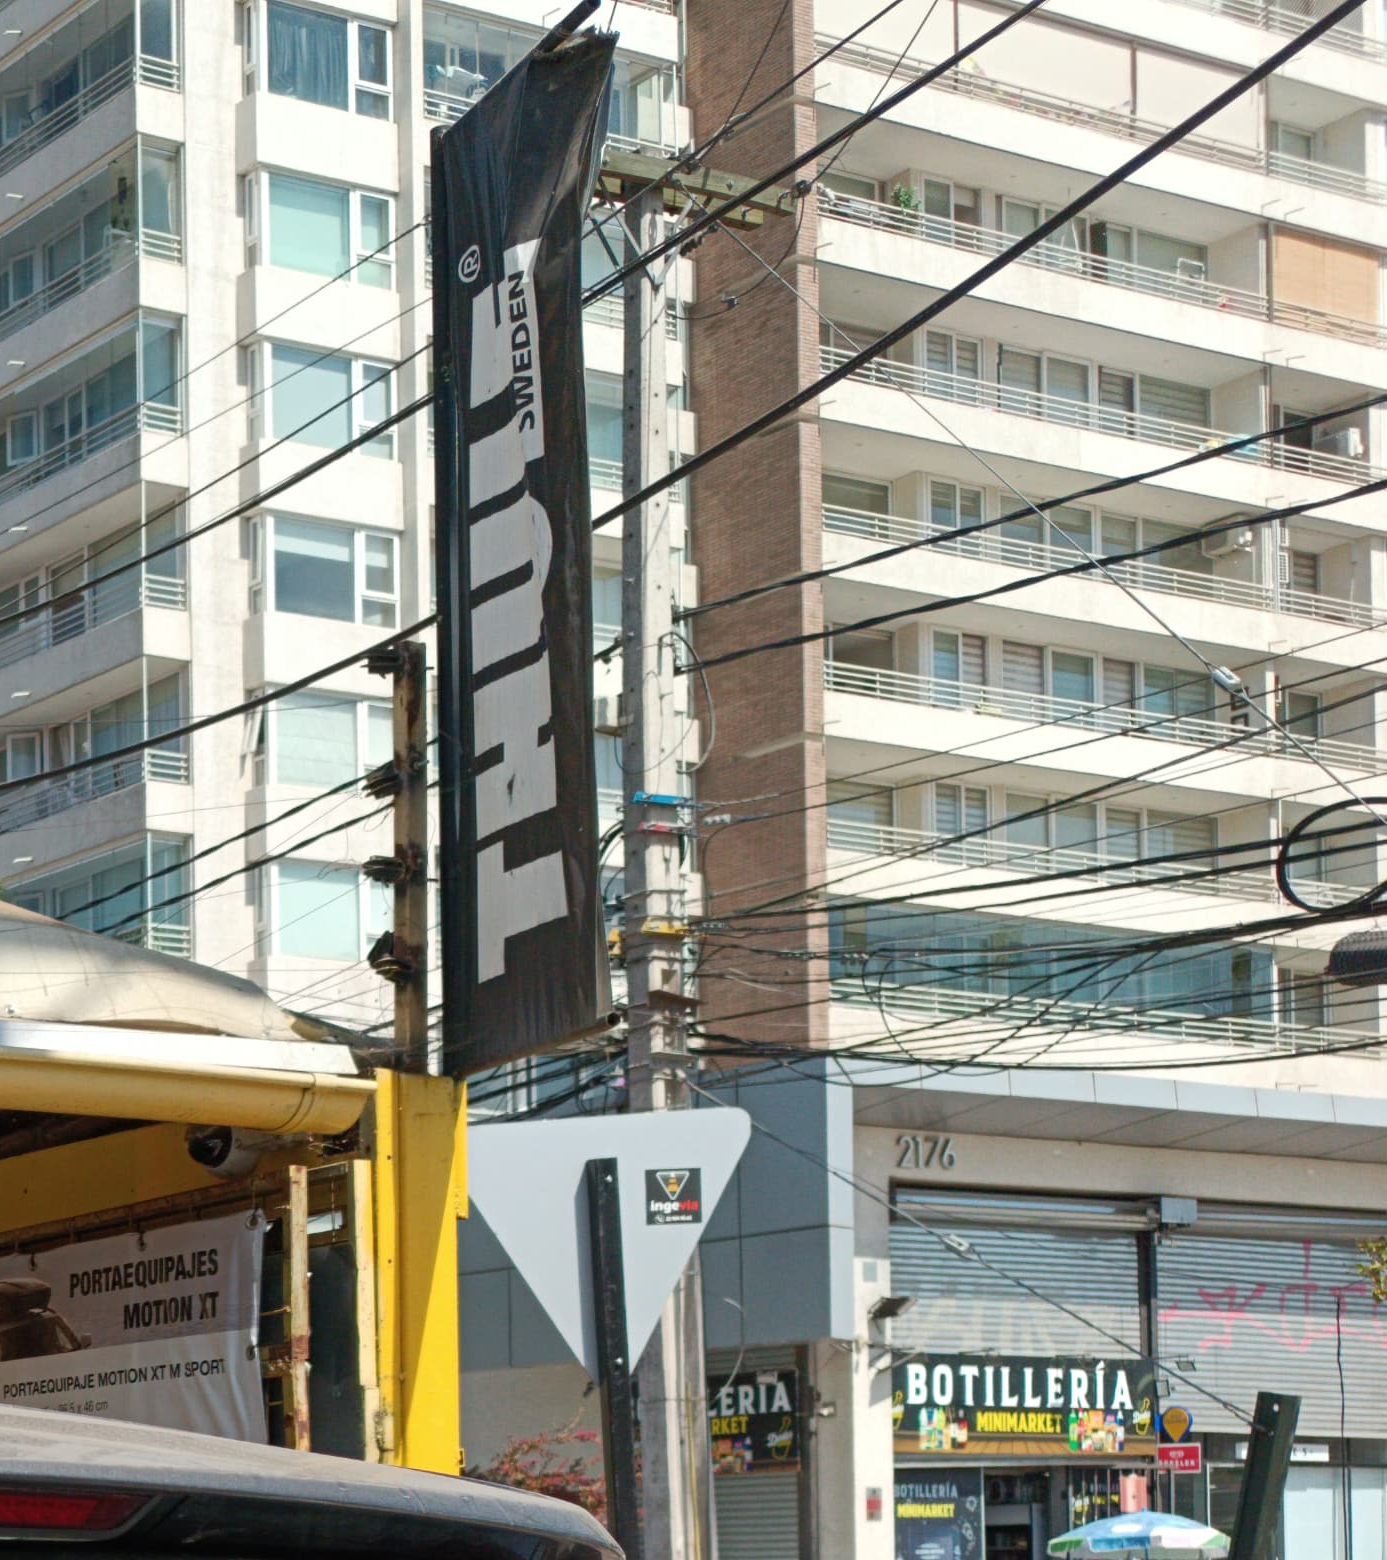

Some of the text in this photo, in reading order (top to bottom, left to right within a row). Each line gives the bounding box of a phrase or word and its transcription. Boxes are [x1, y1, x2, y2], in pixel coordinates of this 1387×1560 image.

[508, 270, 535, 434] SWEDEN
[896, 1134, 956, 1169] 2176
[69, 1249, 219, 1298] PORTAEQUIPAJES
[123, 1291, 220, 1330] MOTION XT
[3, 1358, 225, 1398] PORTAEQUIPAJE MOTION XT M SPORT
[907, 1360, 1134, 1410] BOTILLERÍA
[976, 1411, 1063, 1434] MINIMARKET
